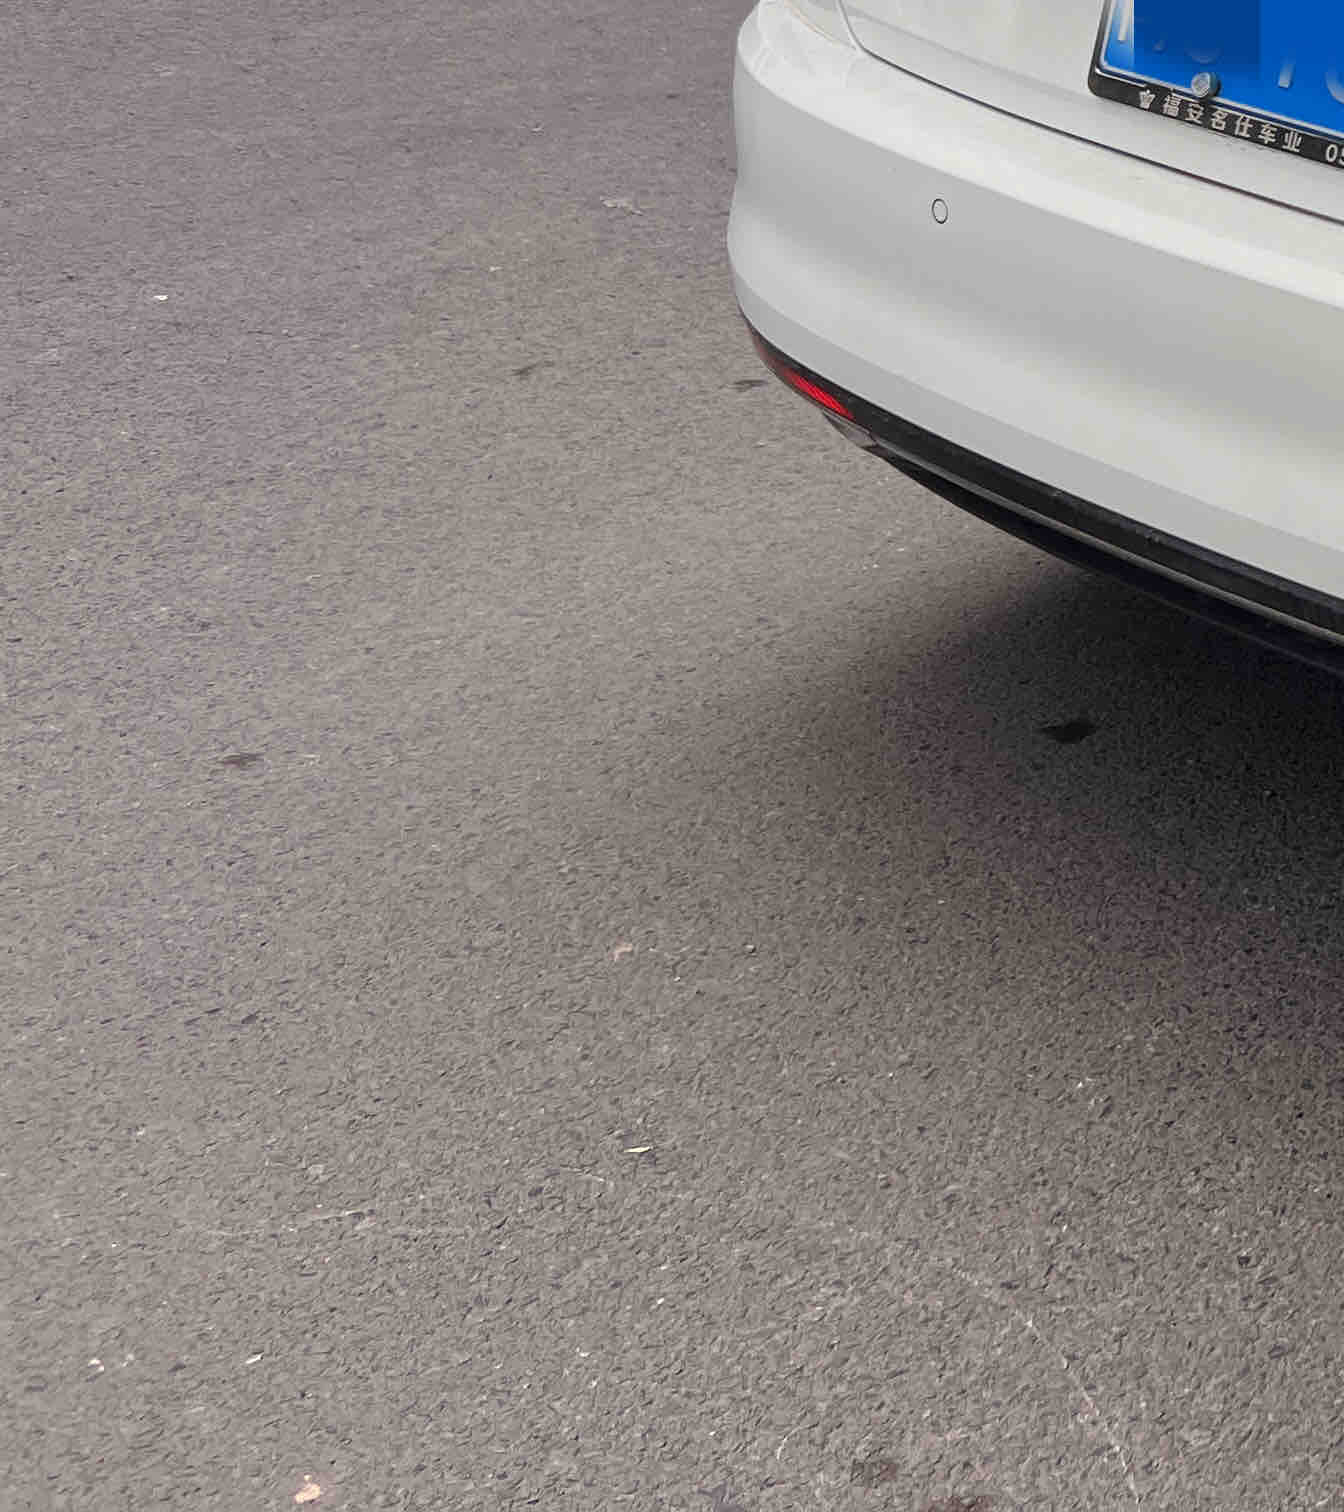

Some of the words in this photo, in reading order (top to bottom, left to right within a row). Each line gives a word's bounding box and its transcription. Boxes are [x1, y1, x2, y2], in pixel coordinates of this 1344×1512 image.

[1162, 93, 1302, 153] 福安名仕车业
